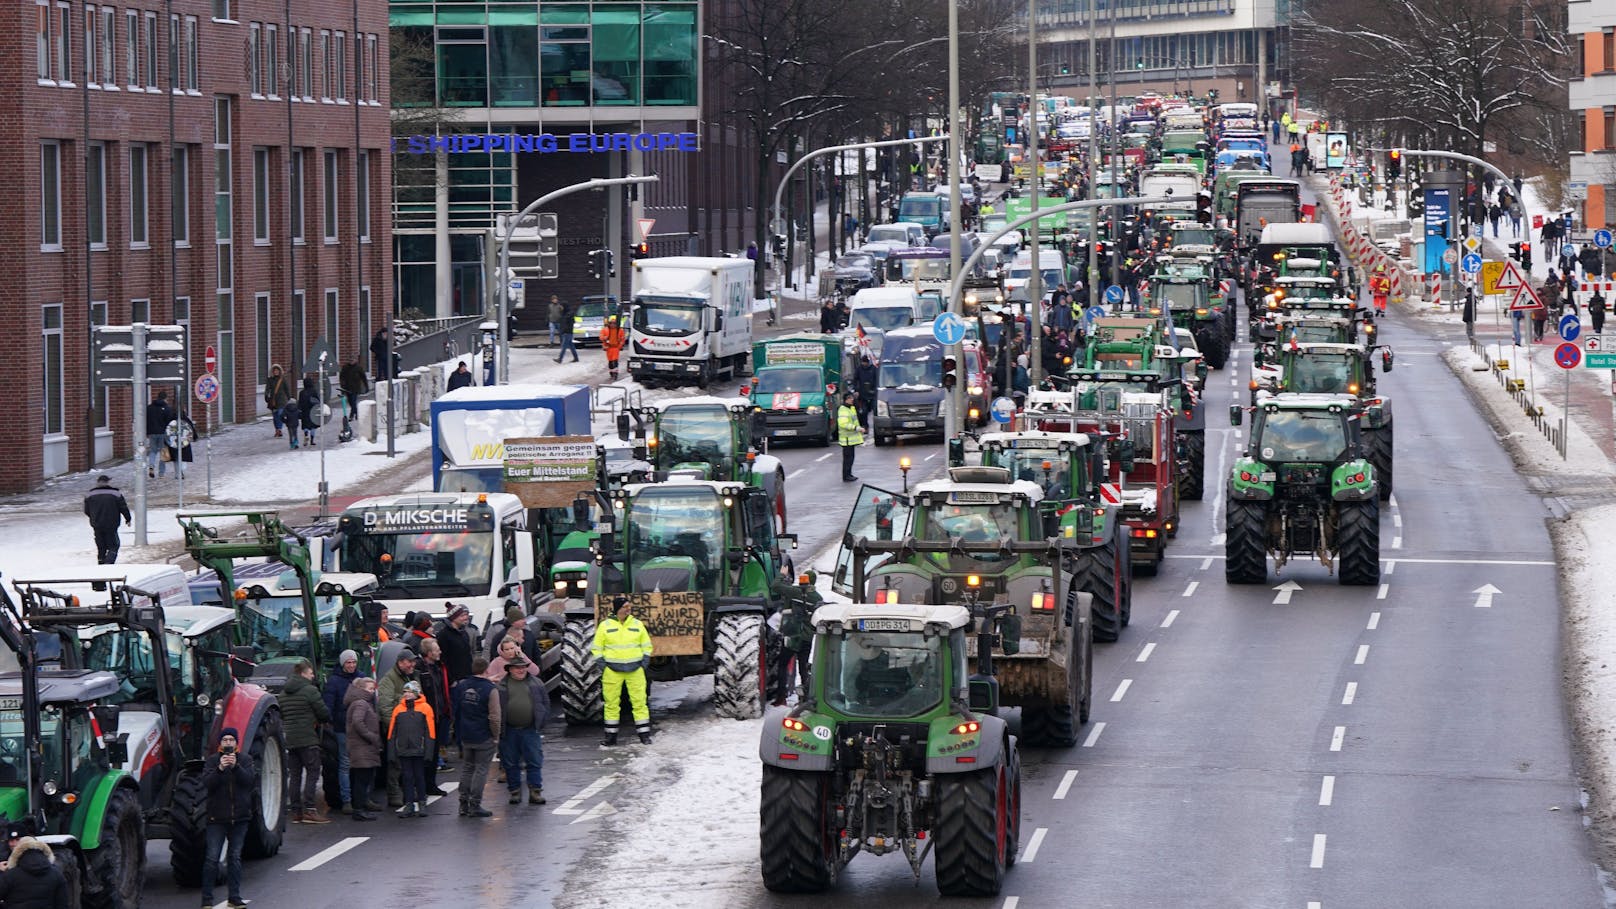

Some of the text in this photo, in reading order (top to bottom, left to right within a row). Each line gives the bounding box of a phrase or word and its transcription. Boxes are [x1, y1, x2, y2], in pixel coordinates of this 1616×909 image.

[407, 132, 697, 155] SHIPPING EUROPE
[505, 444, 592, 453] Gemeinsam gegen
[549, 450, 584, 458] Arroganz
[508, 465, 588, 476] Euer Mittelstand
[385, 509, 468, 525] MIKSCHE
[661, 592, 704, 606] BAUER
[663, 606, 700, 619] WIRD
[880, 620, 893, 629] PG
[893, 620, 909, 629] 314
[816, 727, 829, 738] 40
